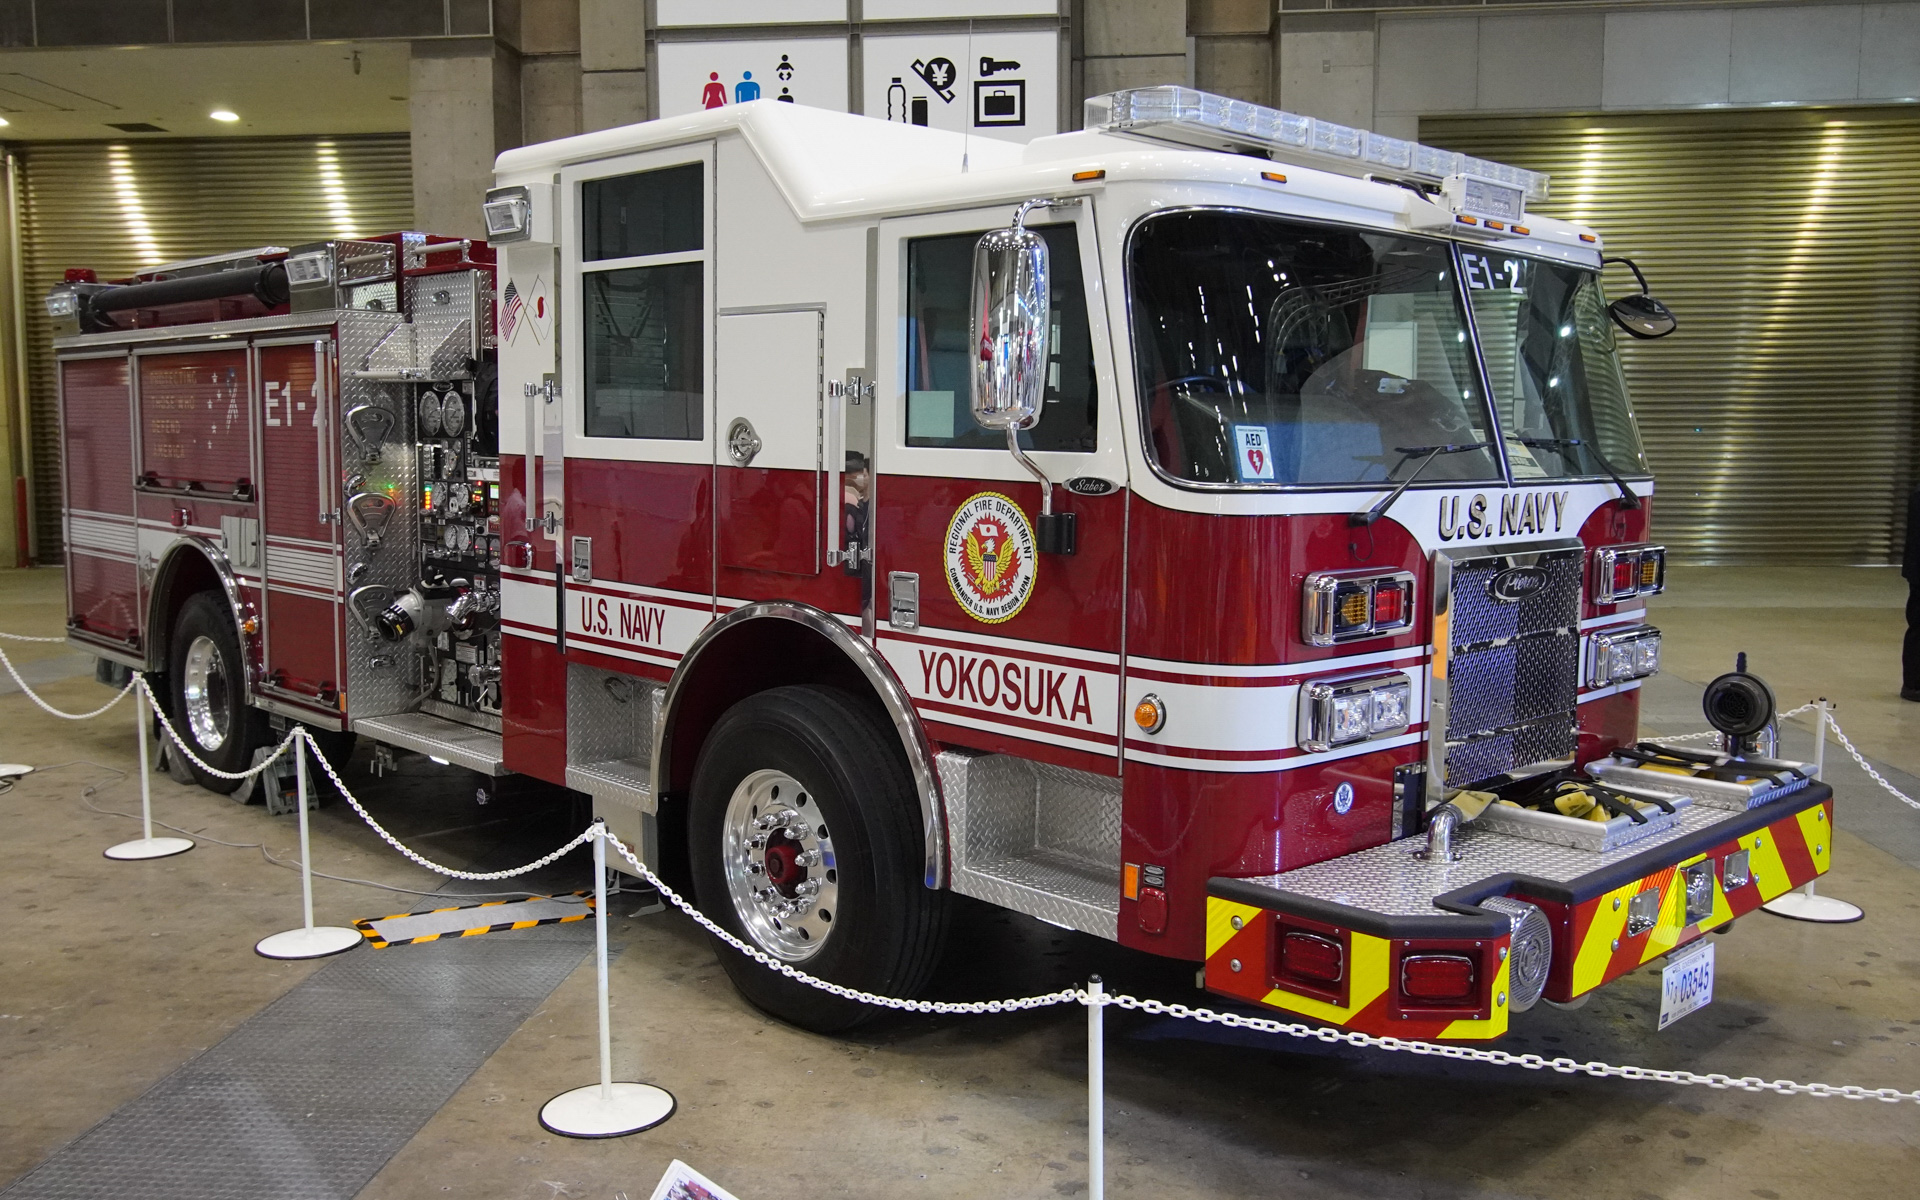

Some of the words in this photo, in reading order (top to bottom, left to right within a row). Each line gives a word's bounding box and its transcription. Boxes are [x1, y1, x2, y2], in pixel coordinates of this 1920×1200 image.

[1462, 253, 1524, 294] E1-2
[1245, 433, 1262, 446] AED
[1075, 479, 1105, 491] Saber
[949, 508, 974, 554] REGIONAL
[974, 500, 993, 513] FIRE
[995, 501, 1033, 560] DEPARTMENT
[1438, 493, 1493, 542] U.S.
[1499, 491, 1569, 537] NAVY
[949, 567, 973, 607] COMMANDER
[973, 602, 985, 615] U.S.
[985, 606, 1000, 616] NAVY
[1000, 595, 1020, 613] REGION
[1019, 575, 1031, 598] JAPAN
[581, 596, 612, 636] U.S.
[620, 602, 665, 645] NAVY
[918, 649, 1093, 725] YOKOSUKA
[1680, 961, 1710, 1003] 03545
